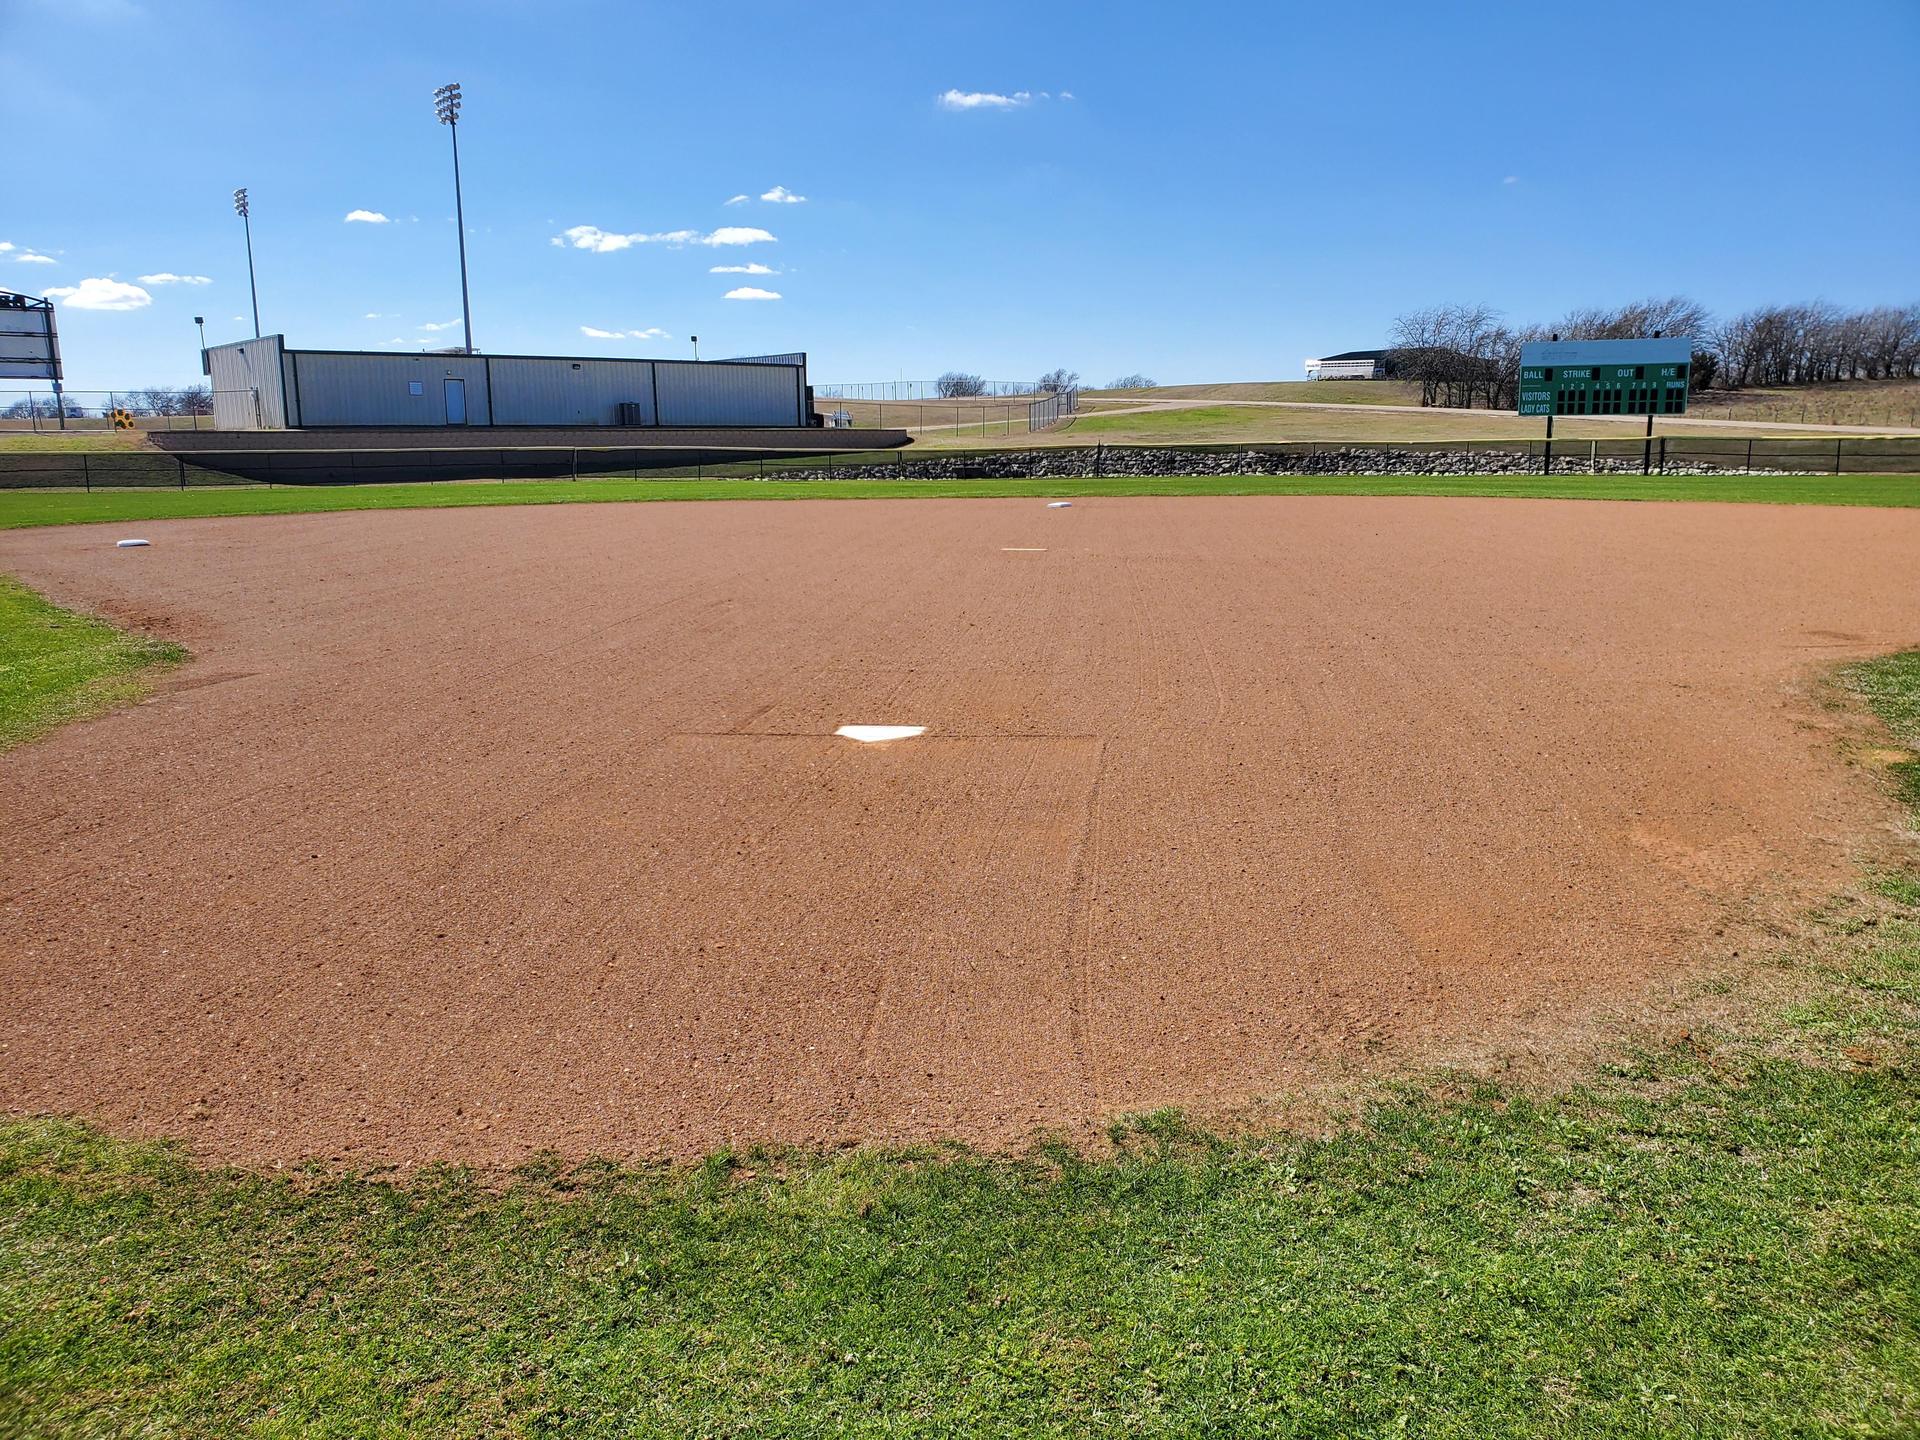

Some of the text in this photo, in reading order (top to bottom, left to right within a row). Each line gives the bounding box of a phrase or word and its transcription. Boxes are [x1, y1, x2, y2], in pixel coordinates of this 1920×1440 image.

[1523, 368, 1676, 379] BALL STRIKE OUT H/E
[1666, 380, 1686, 388] RUNS
[1522, 391, 1551, 401] VISITORS
[1520, 404, 1550, 414] LADY CATS
